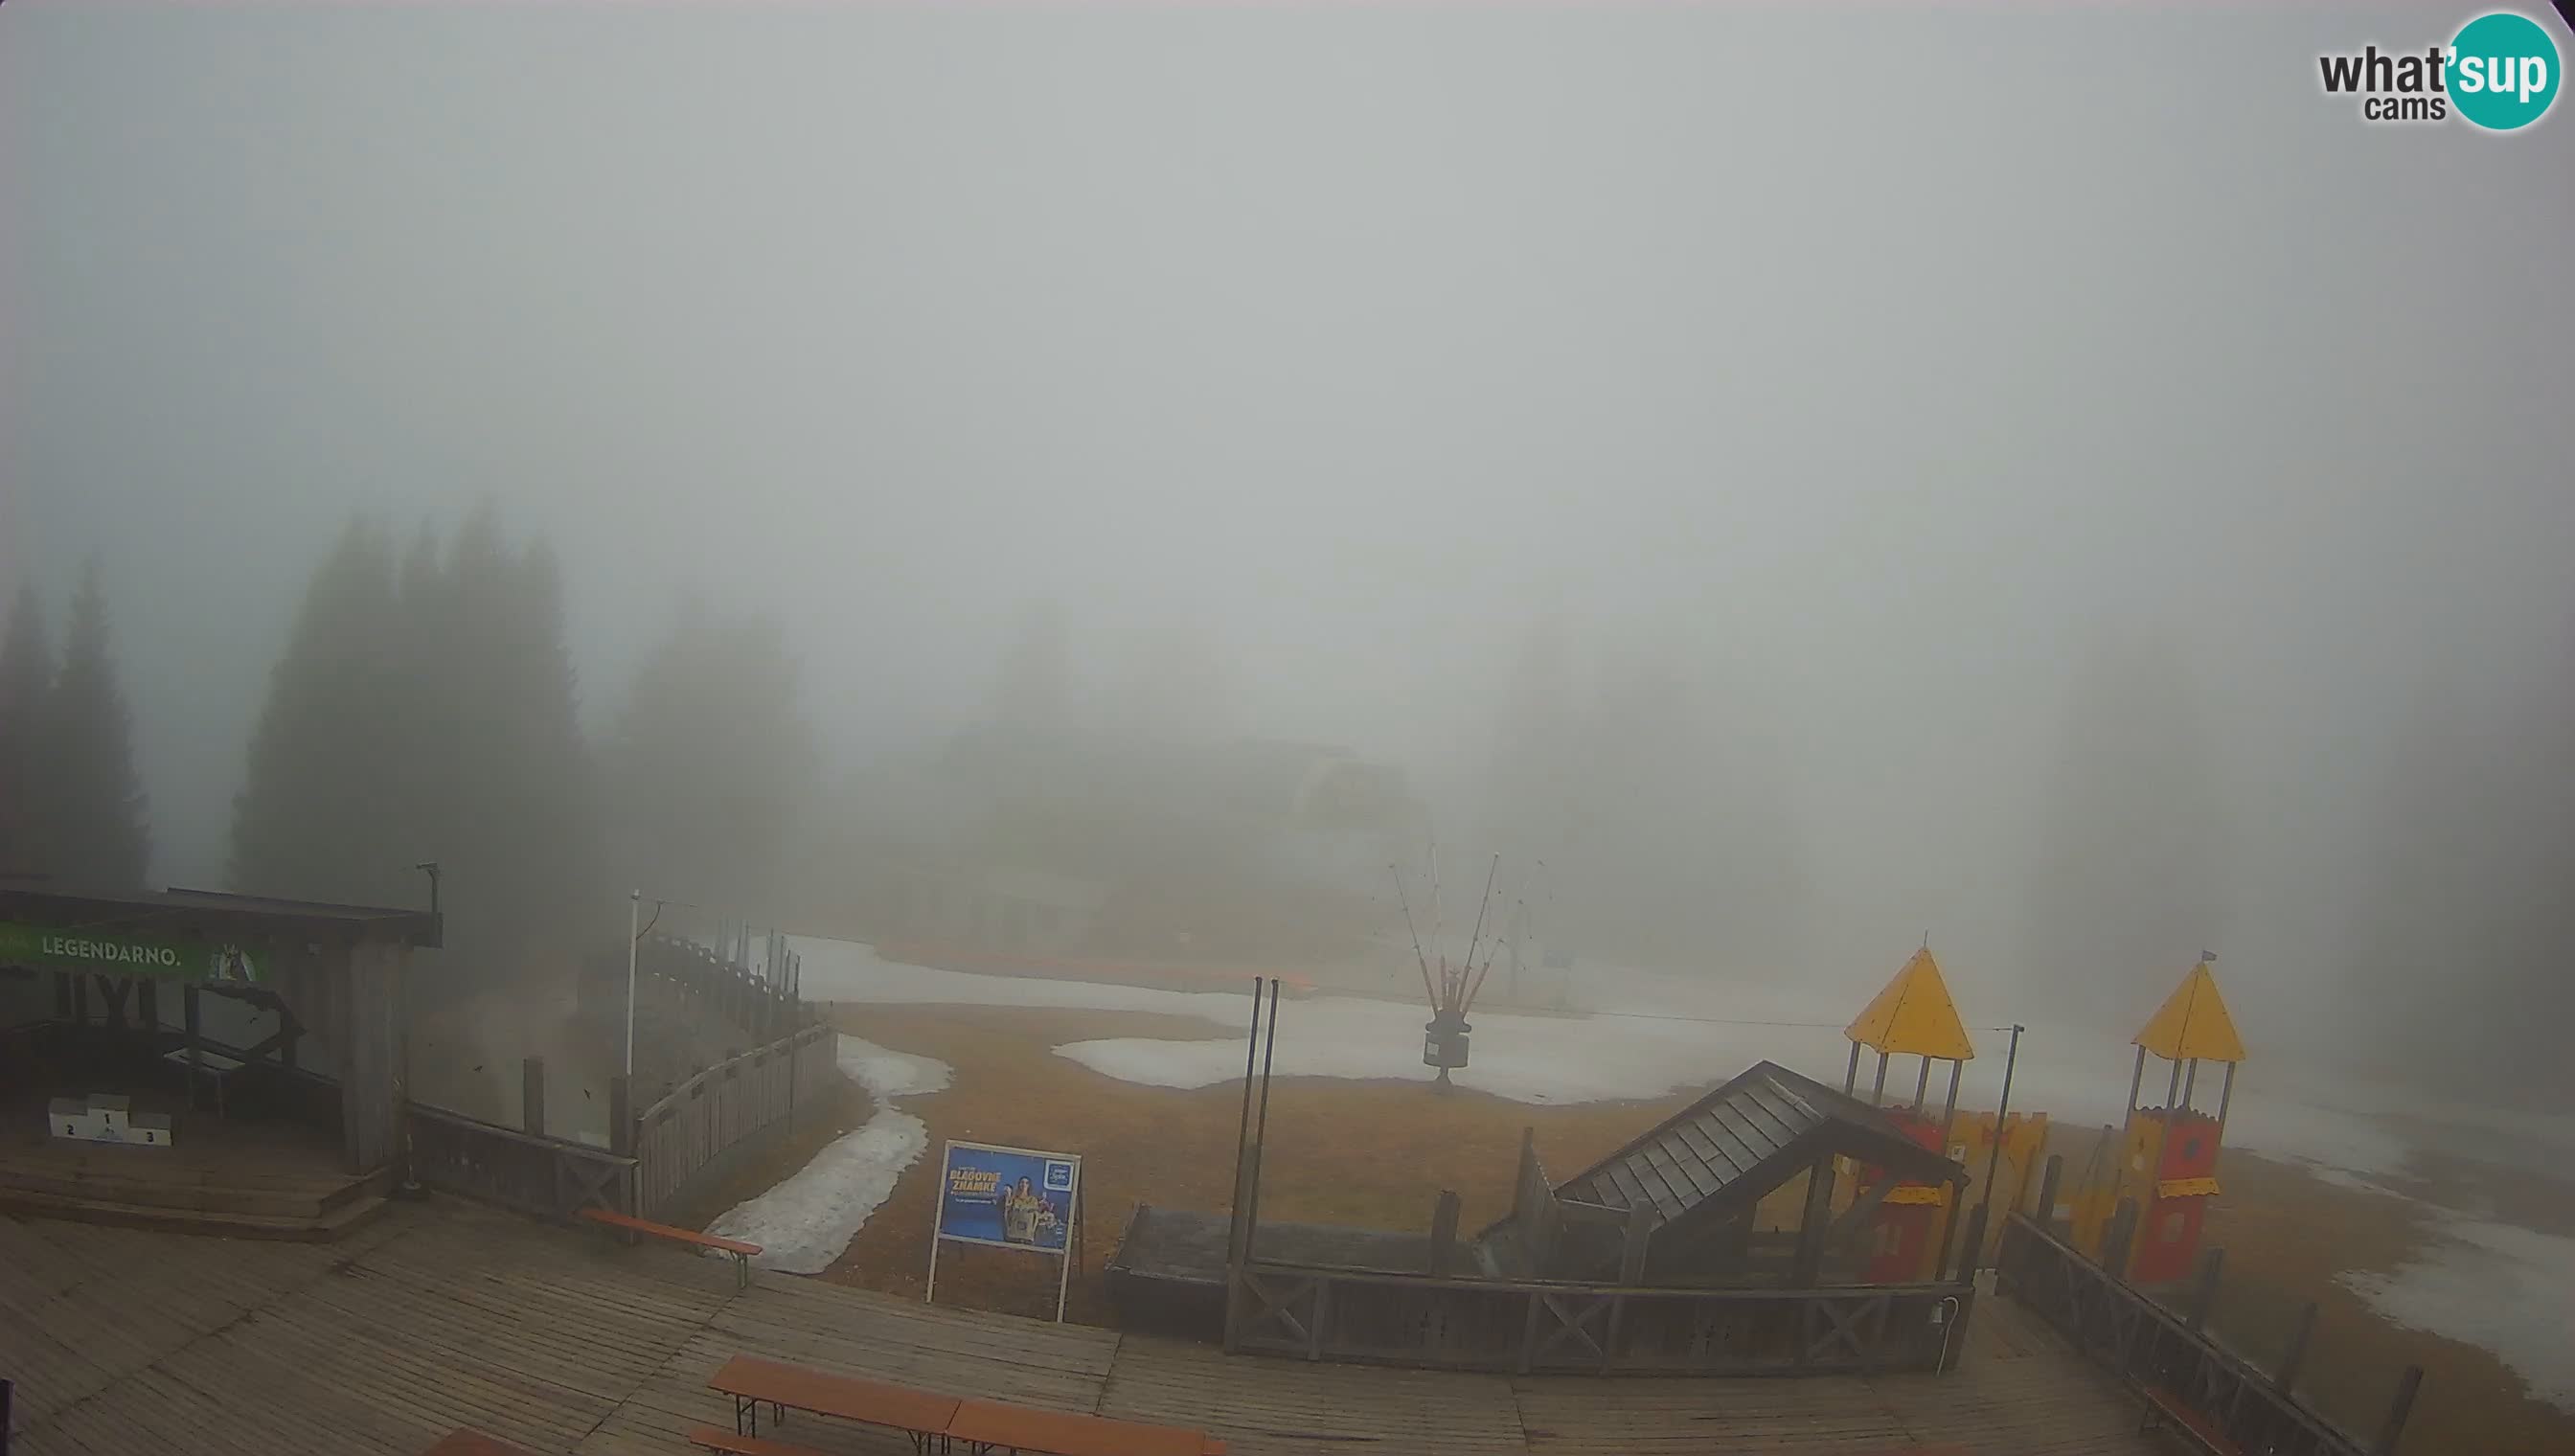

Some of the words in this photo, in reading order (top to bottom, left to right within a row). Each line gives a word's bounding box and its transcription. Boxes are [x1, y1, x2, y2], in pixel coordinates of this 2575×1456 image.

[42, 936, 181, 967] LEGENDARNO.
[104, 1112, 110, 1125] 1
[66, 1125, 74, 1135] 2
[147, 1131, 154, 1143] 3
